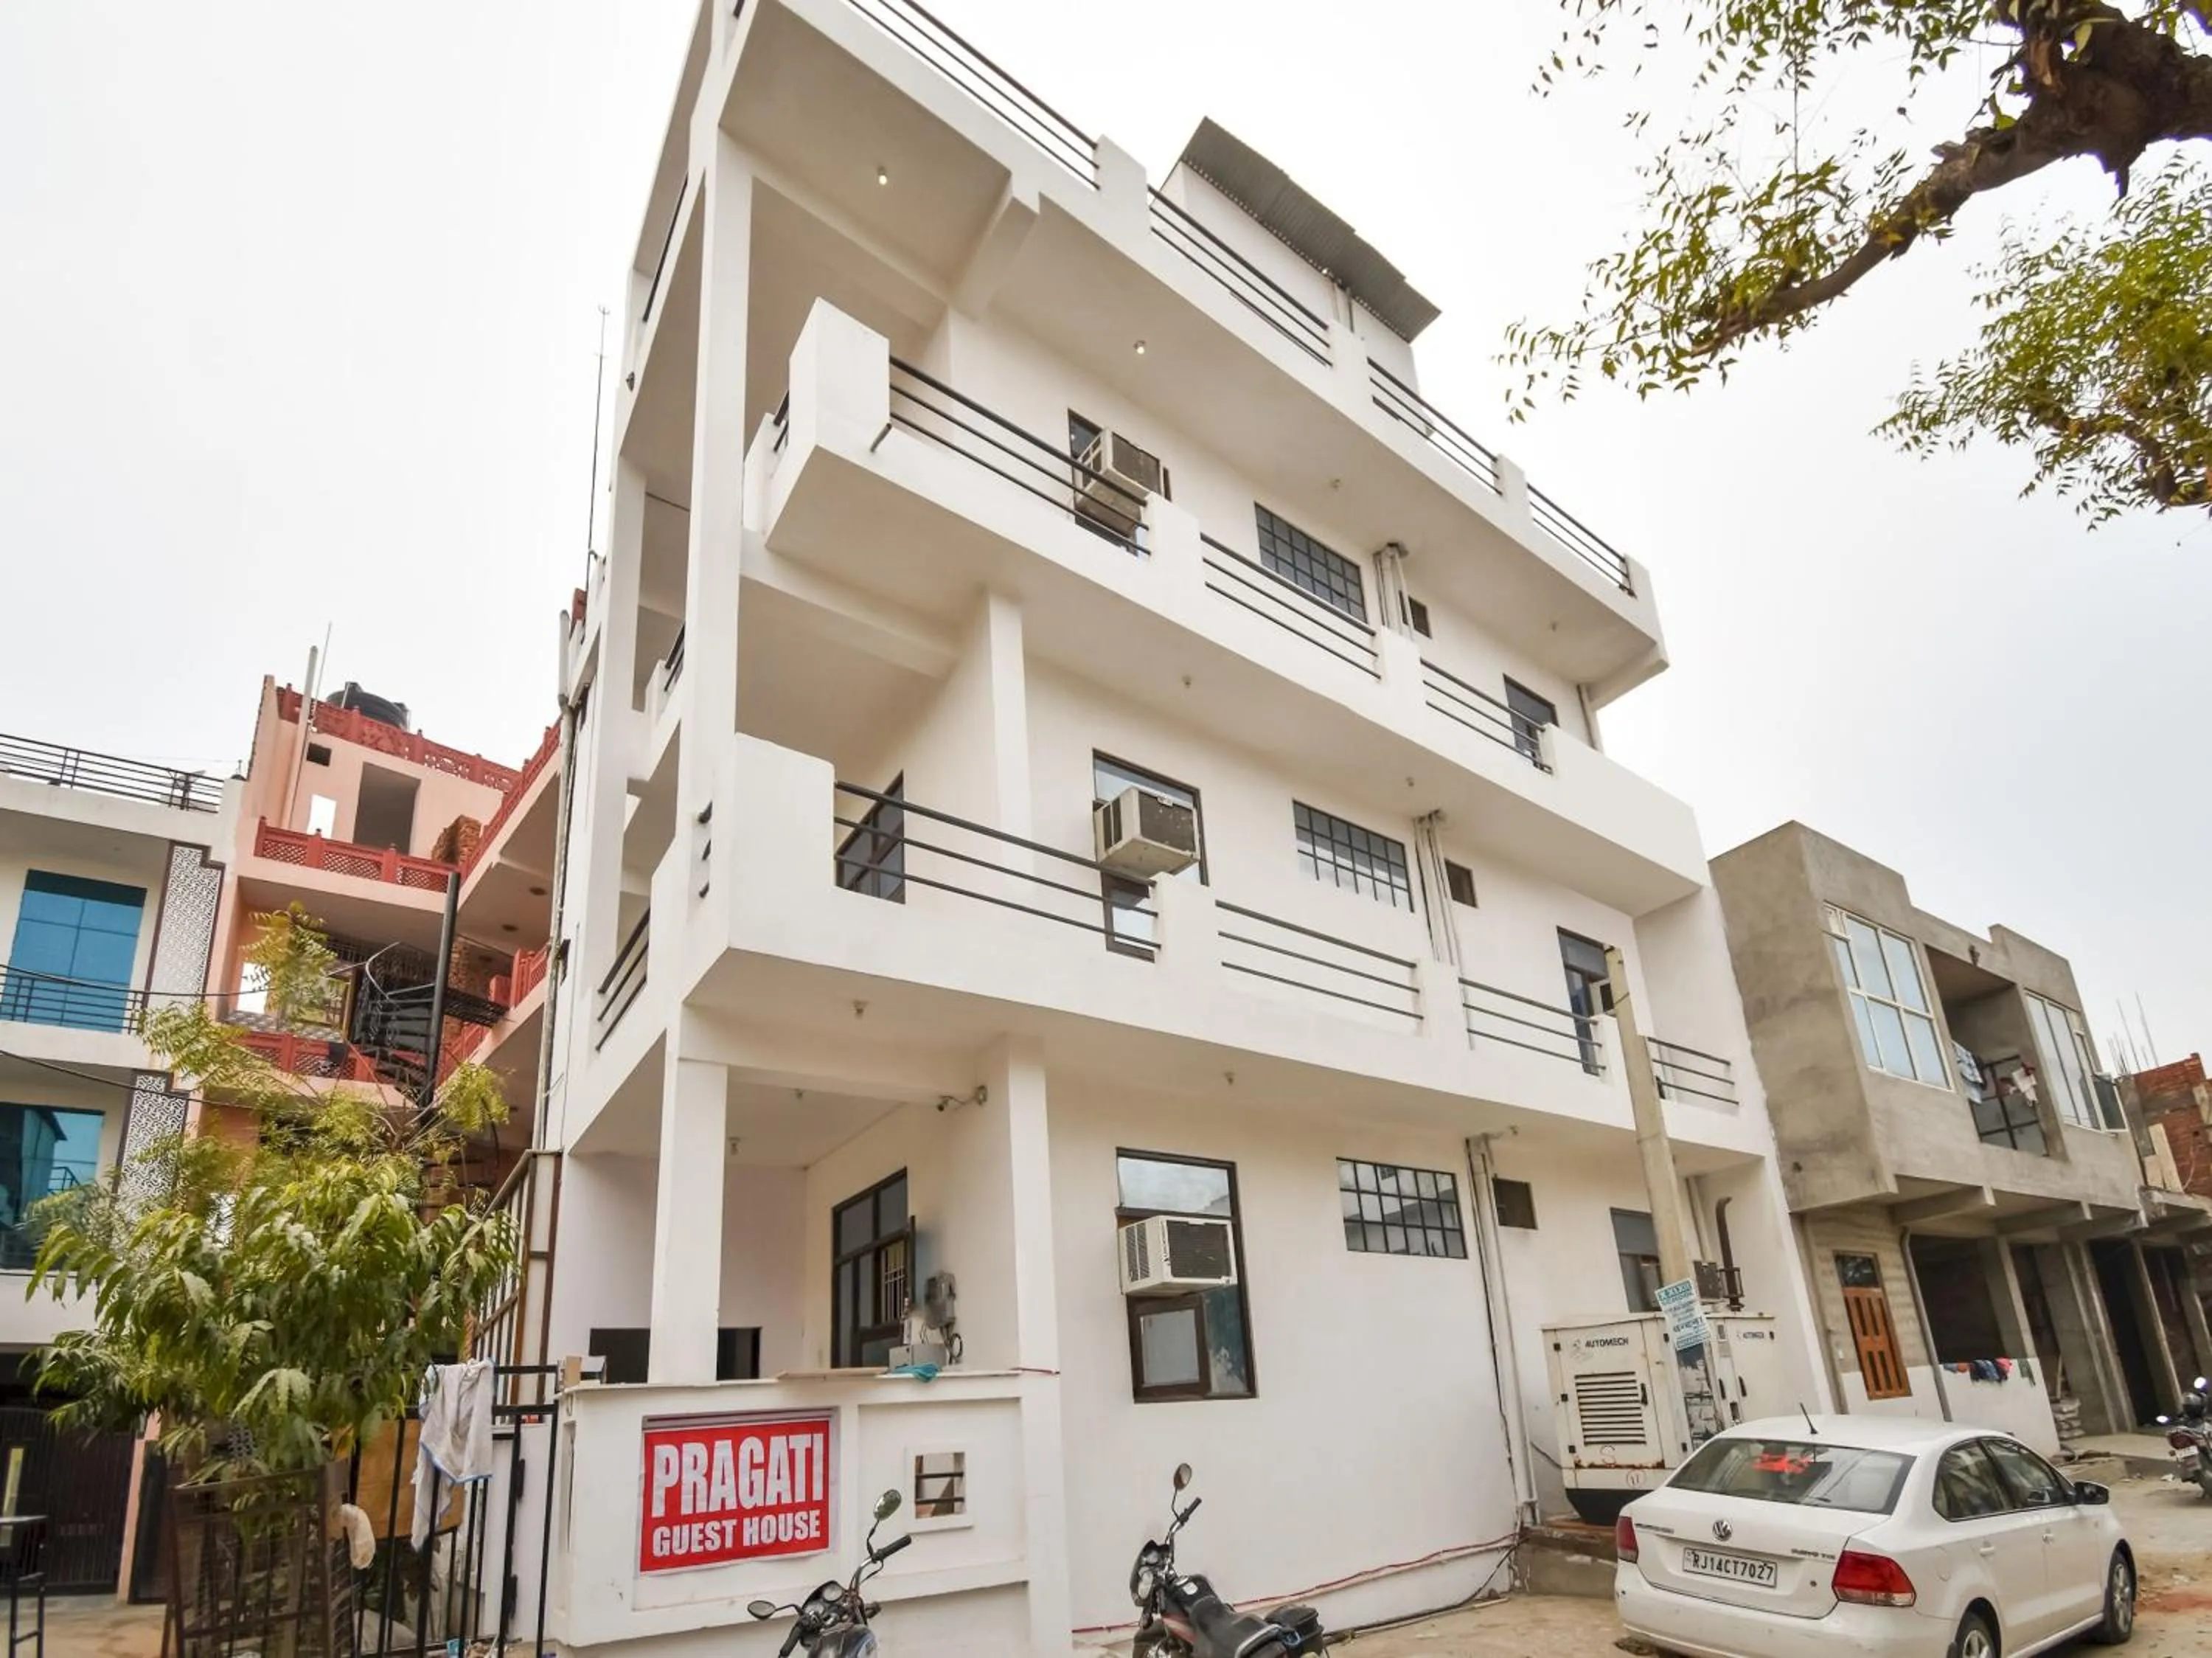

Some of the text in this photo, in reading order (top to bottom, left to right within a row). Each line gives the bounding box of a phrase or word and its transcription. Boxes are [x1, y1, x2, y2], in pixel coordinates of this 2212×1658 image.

[651, 1433, 824, 1518] PRAGATI
[653, 1510, 821, 1558] GUEST HOUSE
[1692, 1551, 1774, 1581] RJ14CT7027
